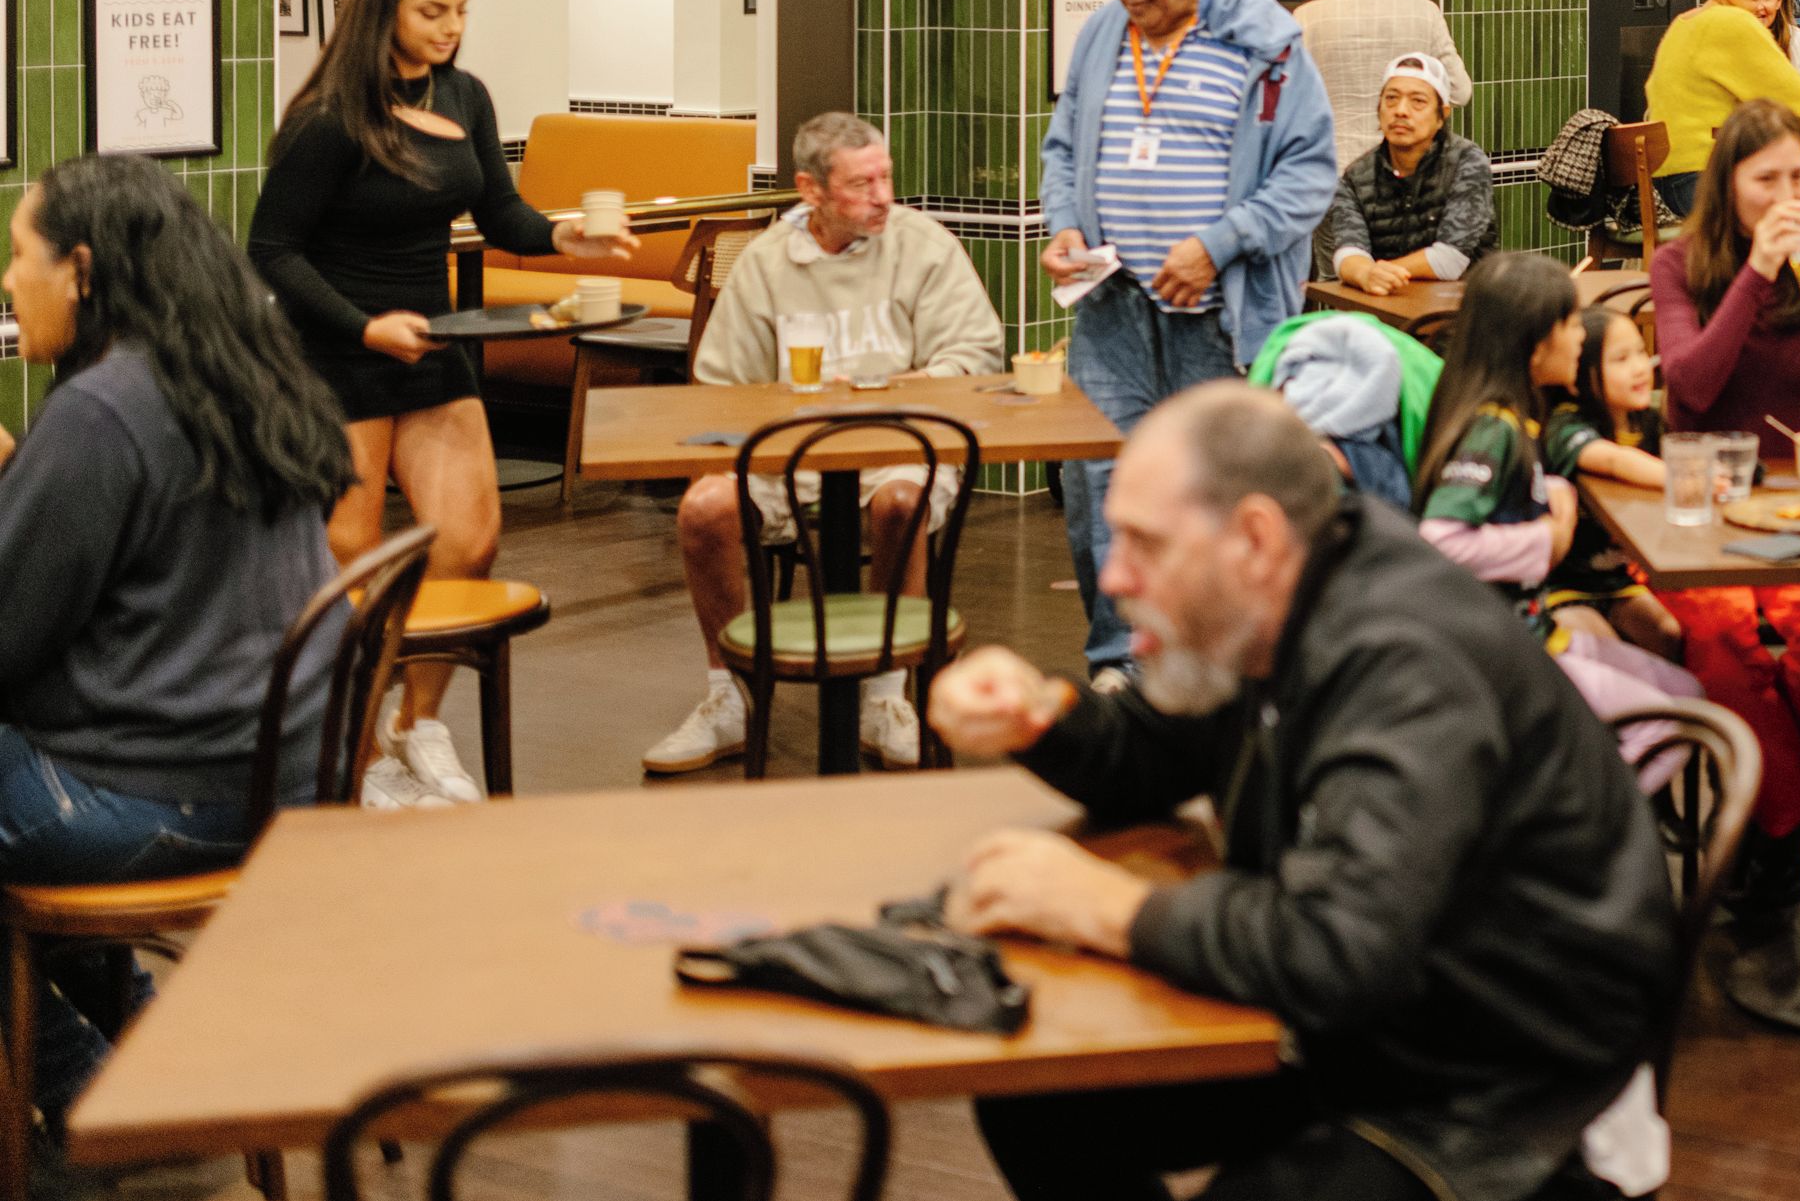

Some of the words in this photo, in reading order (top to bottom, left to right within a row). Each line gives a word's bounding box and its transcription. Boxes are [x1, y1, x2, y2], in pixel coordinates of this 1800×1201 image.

[111, 13, 155, 29] KIDS
[163, 12, 196, 26] EAT
[129, 33, 180, 49] FREE!
